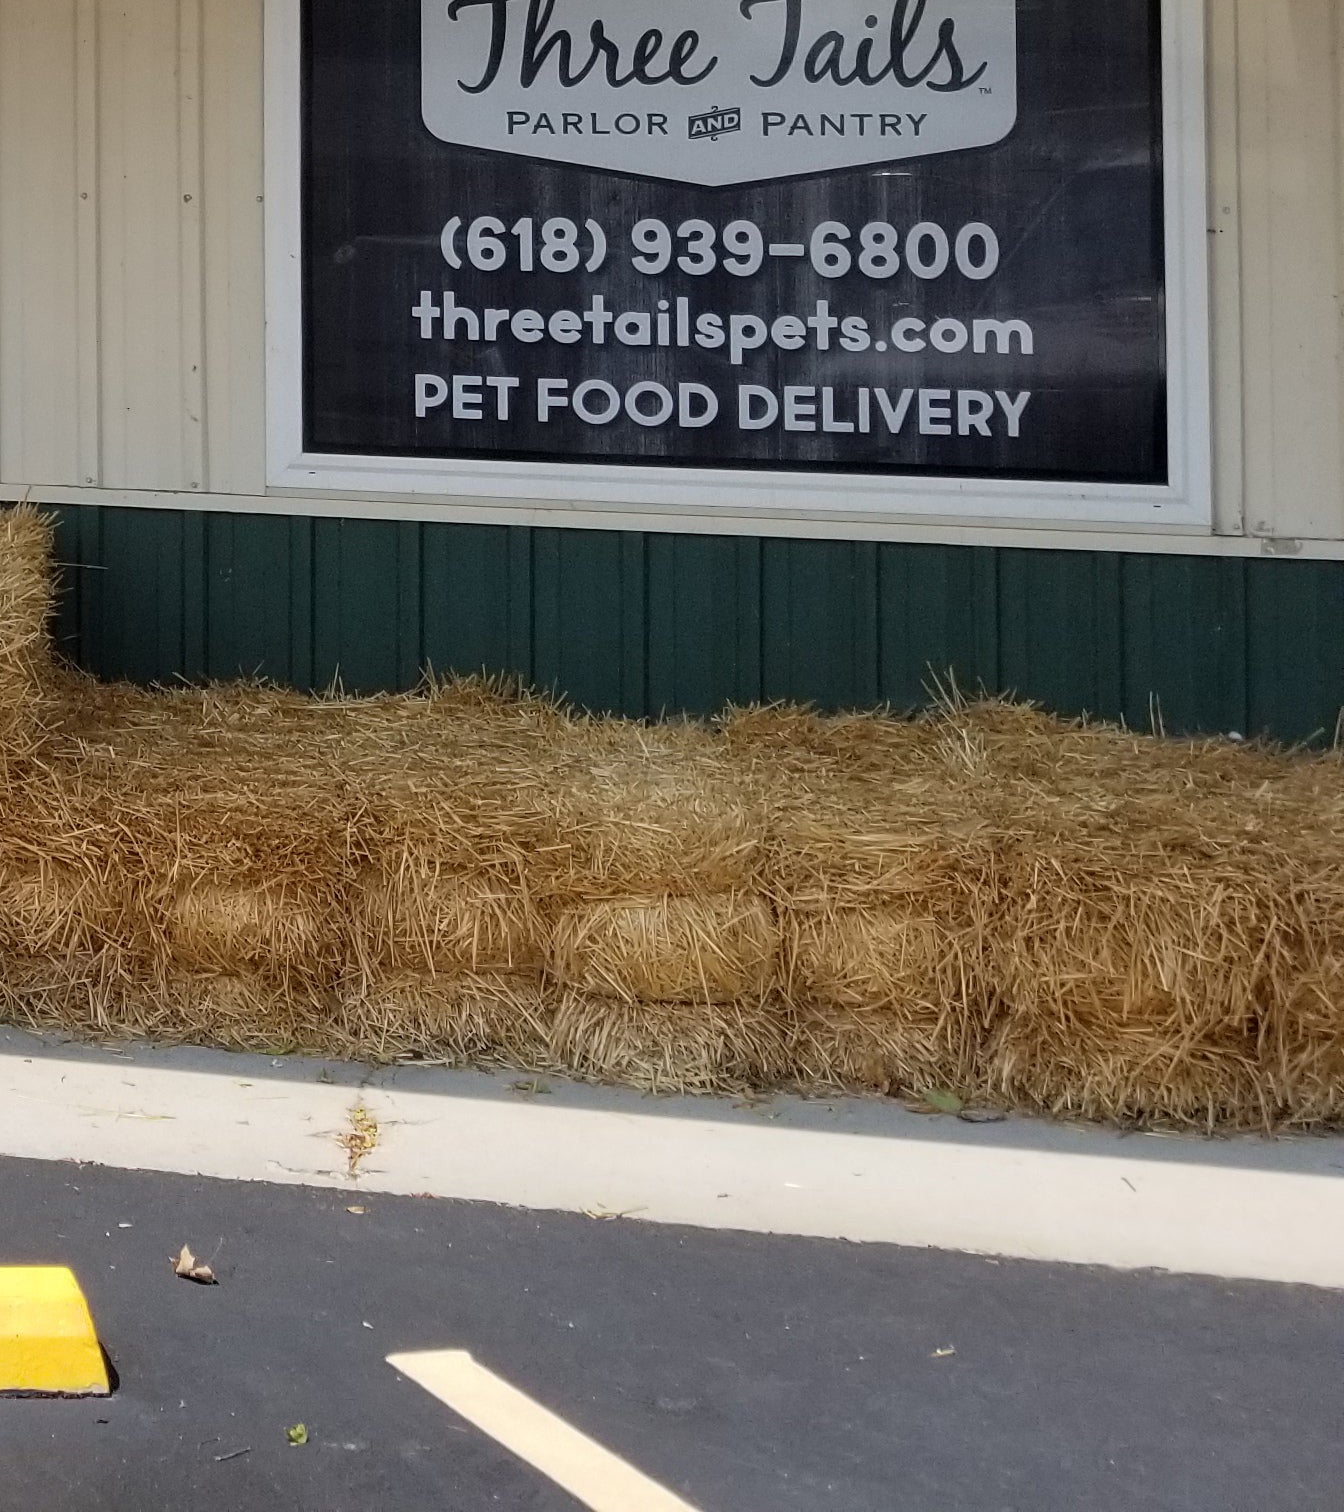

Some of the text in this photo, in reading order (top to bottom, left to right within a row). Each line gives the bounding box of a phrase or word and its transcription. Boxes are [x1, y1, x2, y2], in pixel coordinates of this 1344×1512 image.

[506, 110, 928, 137] PARLOR AND PANTRY
[440, 215, 999, 280] (618) 939-6800
[412, 290, 1034, 365] threetailspets.com
[414, 373, 1031, 438] PET FOOD DELIVERY
